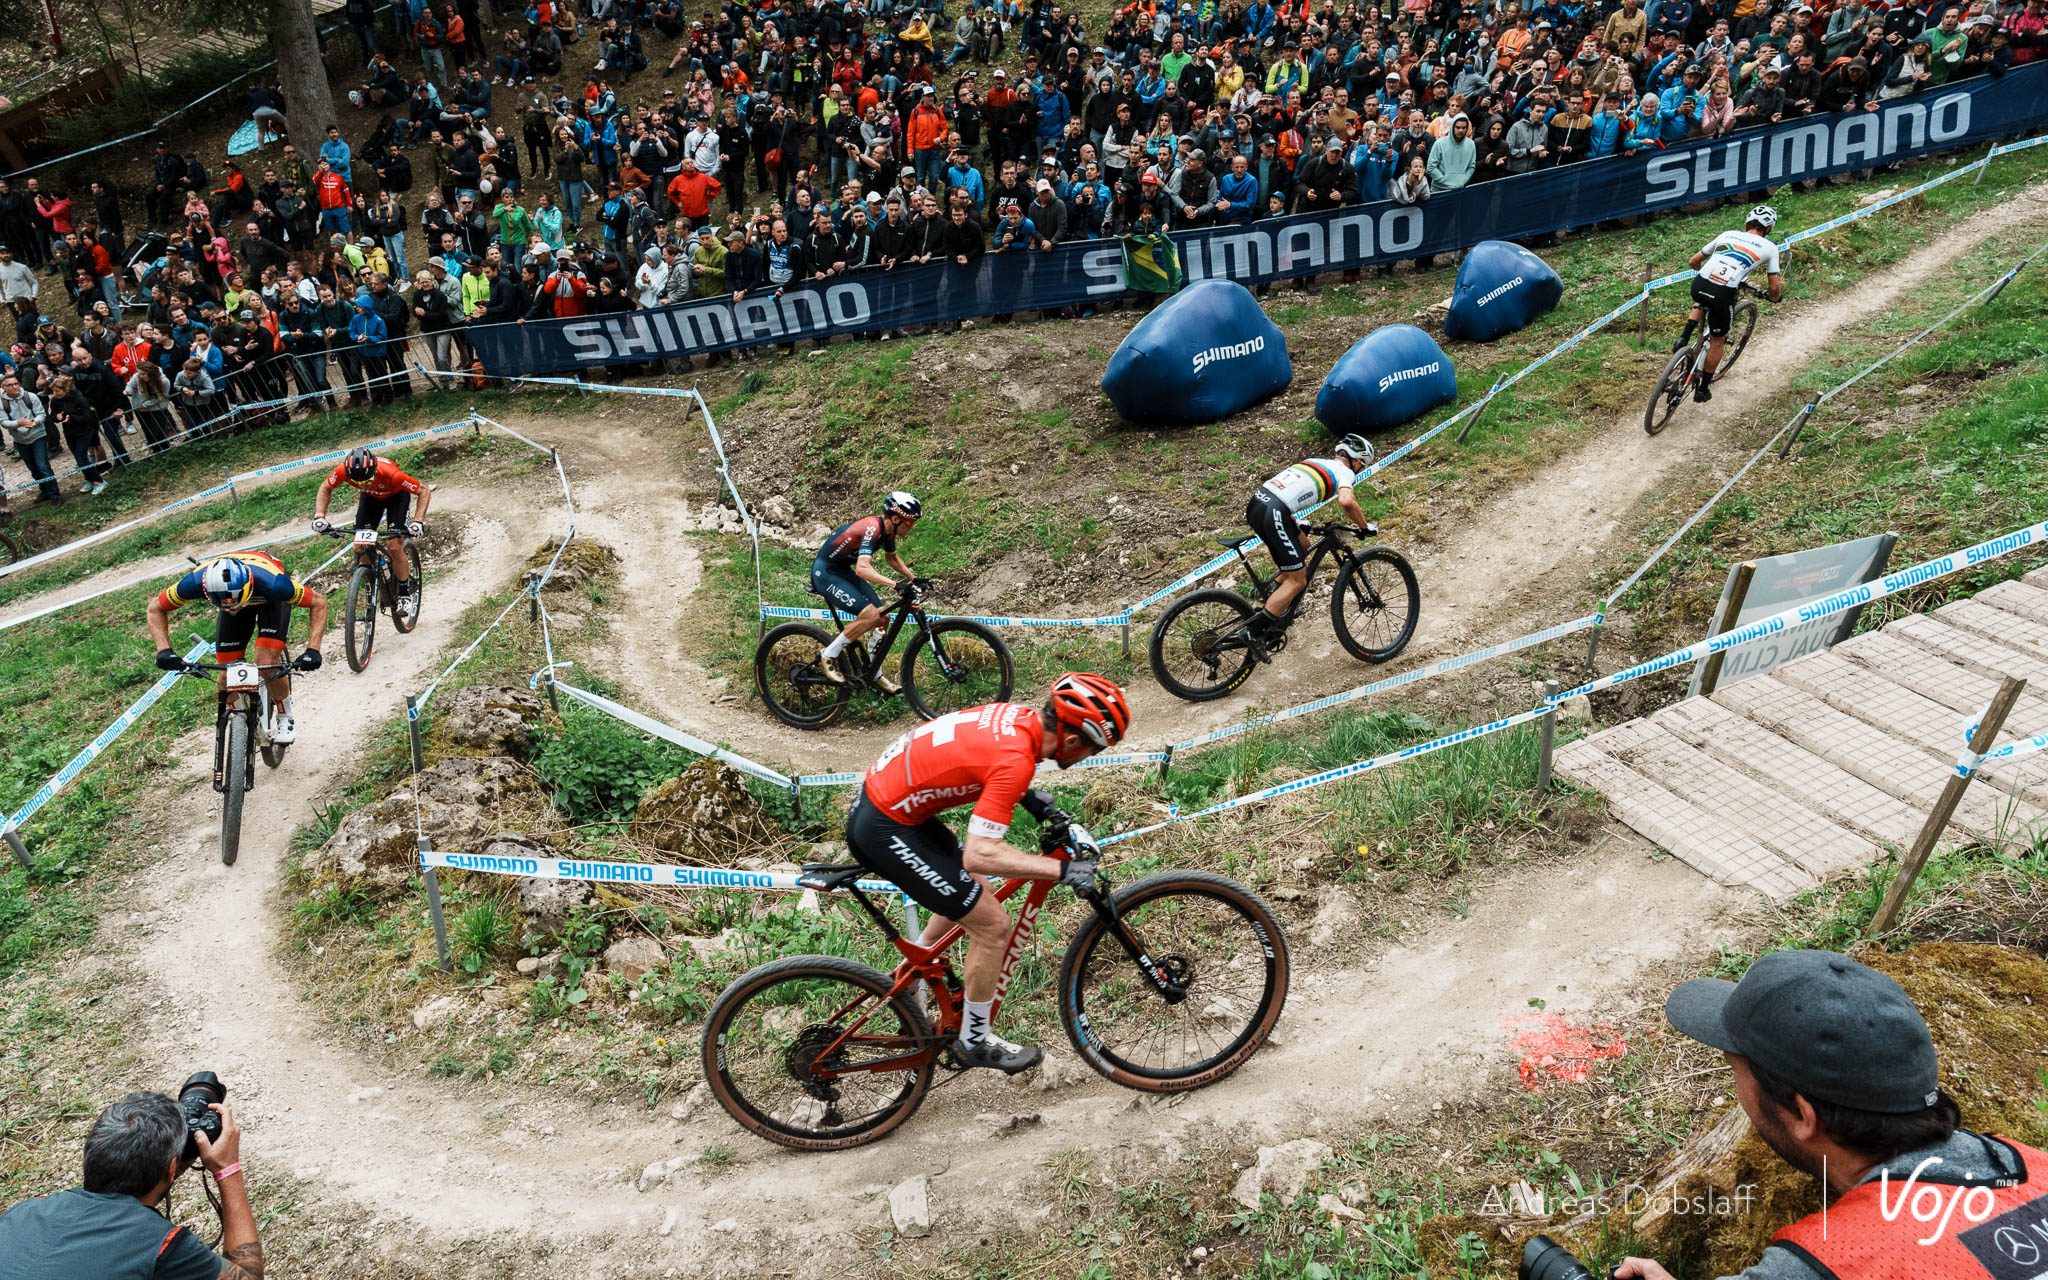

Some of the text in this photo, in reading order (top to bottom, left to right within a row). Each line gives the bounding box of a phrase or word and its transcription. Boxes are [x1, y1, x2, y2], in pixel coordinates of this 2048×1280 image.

[1645, 92, 1972, 203] SHIMANO
[1082, 206, 1424, 296] SIMANO
[1719, 266, 1727, 276] 3
[1476, 276, 1523, 308] SHIMANO
[562, 282, 871, 363] SHIMANO
[1192, 335, 1265, 374] SHIMANO
[1379, 361, 1440, 393] SHIMANO
[1378, 419, 1452, 469] SHIMANO SHIMANO
[360, 532, 372, 540] 12
[861, 525, 877, 547] INEOS
[1272, 508, 1299, 558] SCOTT
[825, 584, 857, 607] INEOS
[1709, 616, 1784, 653] SHIMANO
[1798, 586, 1871, 623] SHIMANO
[1884, 557, 1953, 593] SHIMANO
[1967, 530, 2032, 565] SHIMANO
[237, 669, 248, 683] 9
[12, 784, 54, 826] SHIMANO
[57, 749, 94, 786] SHIMANO
[96, 716, 129, 751] SHIMANO
[445, 853, 538, 875] SHIMANO
[558, 860, 653, 883] SHIMANO
[675, 867, 773, 889] SHIMANO
[1138, 953, 1167, 990] DT SWISS
[967, 1011, 987, 1046] NW
[909, 1069, 919, 1085] DT
[1159, 1038, 1257, 1089] RACING RALPH
[808, 1135, 860, 1148] RALPH
